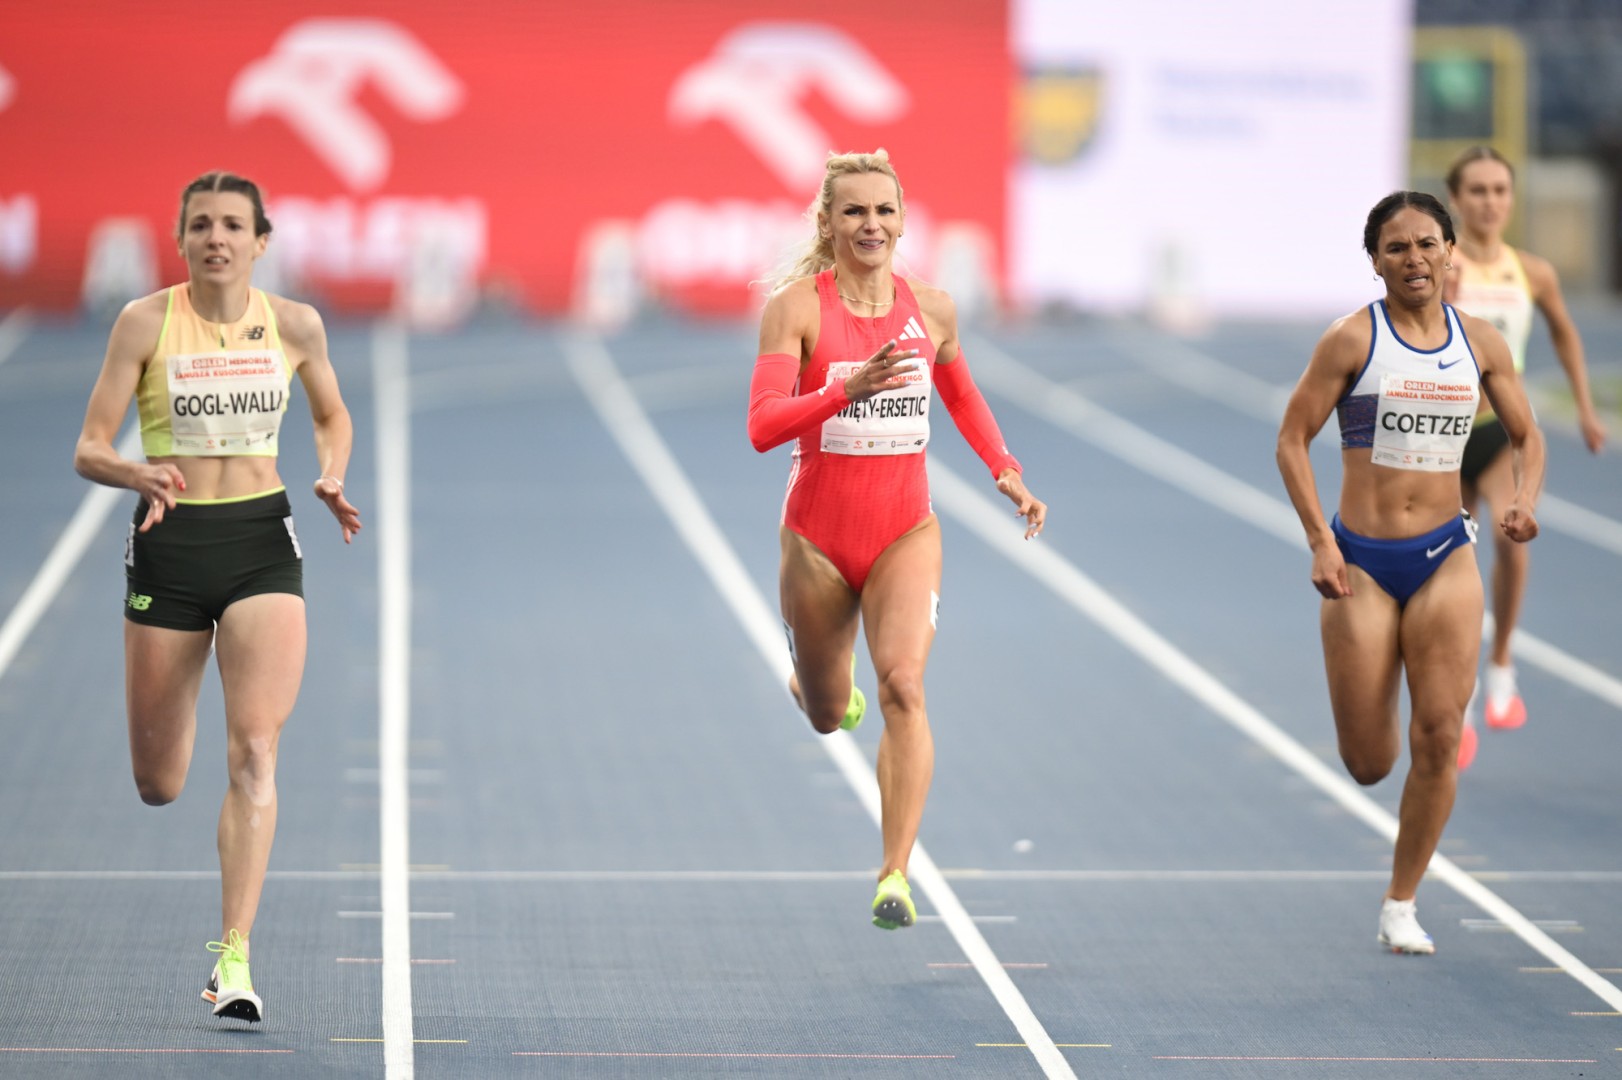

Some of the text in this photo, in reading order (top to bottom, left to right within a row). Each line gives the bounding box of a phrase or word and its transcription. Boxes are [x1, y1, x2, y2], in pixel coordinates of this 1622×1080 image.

[1405, 381, 1434, 390] ORLEN
[1386, 390, 1418, 399] JANUSZA
[837, 396, 927, 423] WIĘTY-ERSETIC
[1382, 411, 1471, 436] COETZEE
